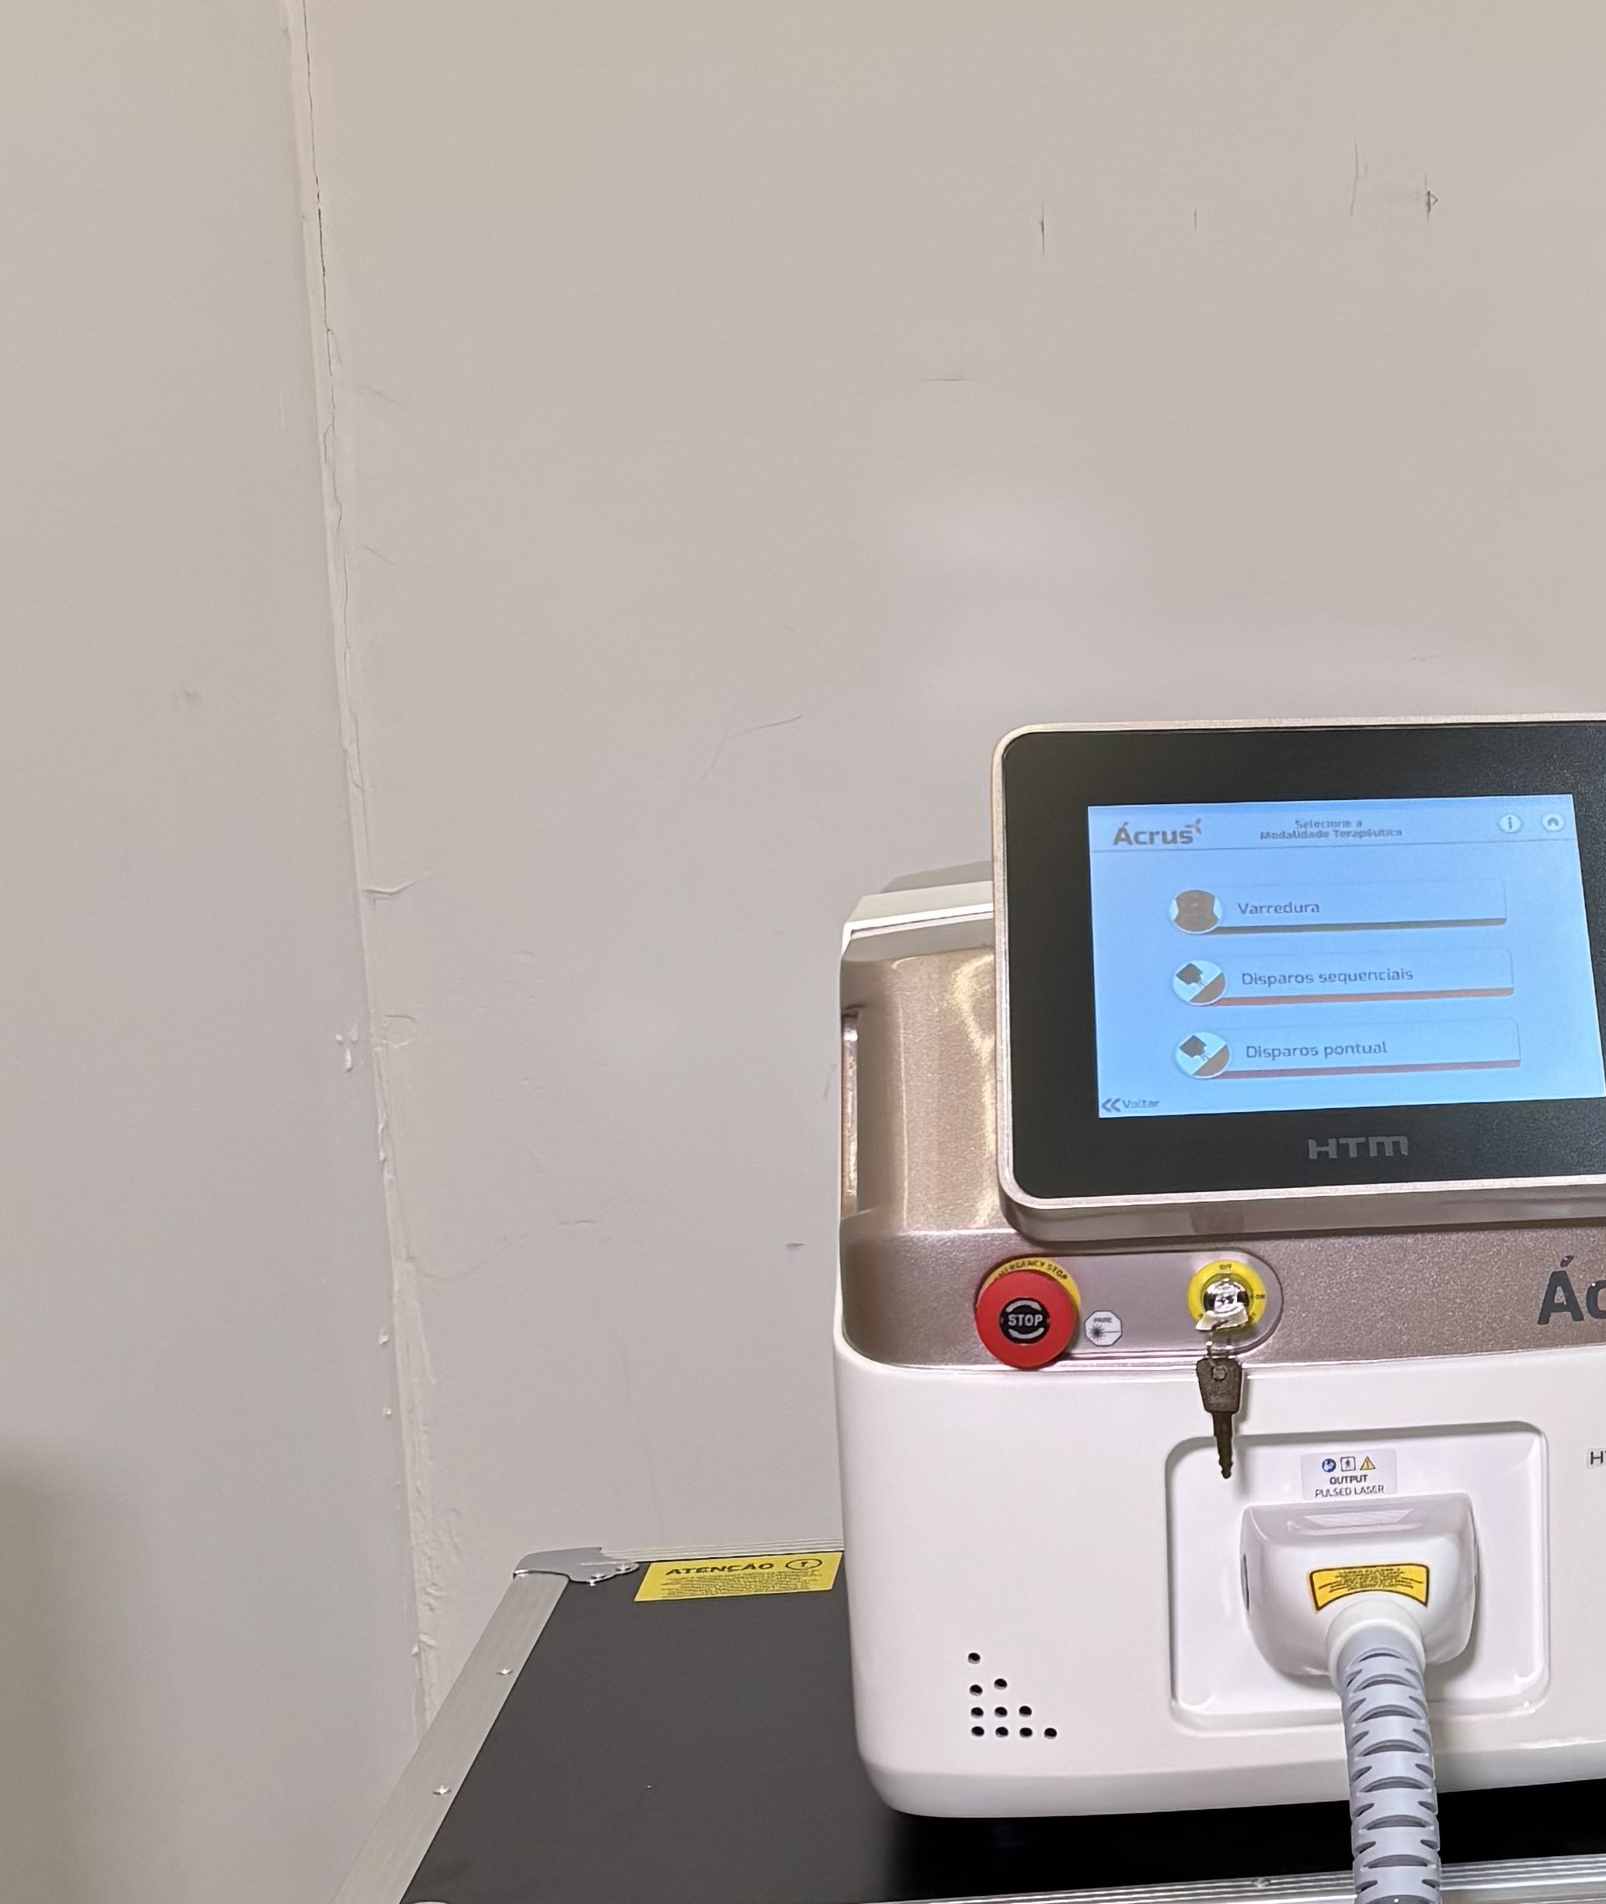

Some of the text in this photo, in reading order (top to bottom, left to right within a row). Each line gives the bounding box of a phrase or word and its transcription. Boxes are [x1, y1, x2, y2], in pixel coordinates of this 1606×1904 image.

[1113, 822, 1194, 845] Ácrus
[1237, 901, 1320, 915] Varredura
[1241, 968, 1414, 988] Disparos sequenciais
[1246, 1041, 1388, 1061] Disparos pontual
[1307, 1136, 1409, 1160] HTM
[1007, 1313, 1044, 1327] STOP
[1329, 1474, 1369, 1485] OUTPUT
[1314, 1484, 1385, 1498] PULSED LASER
